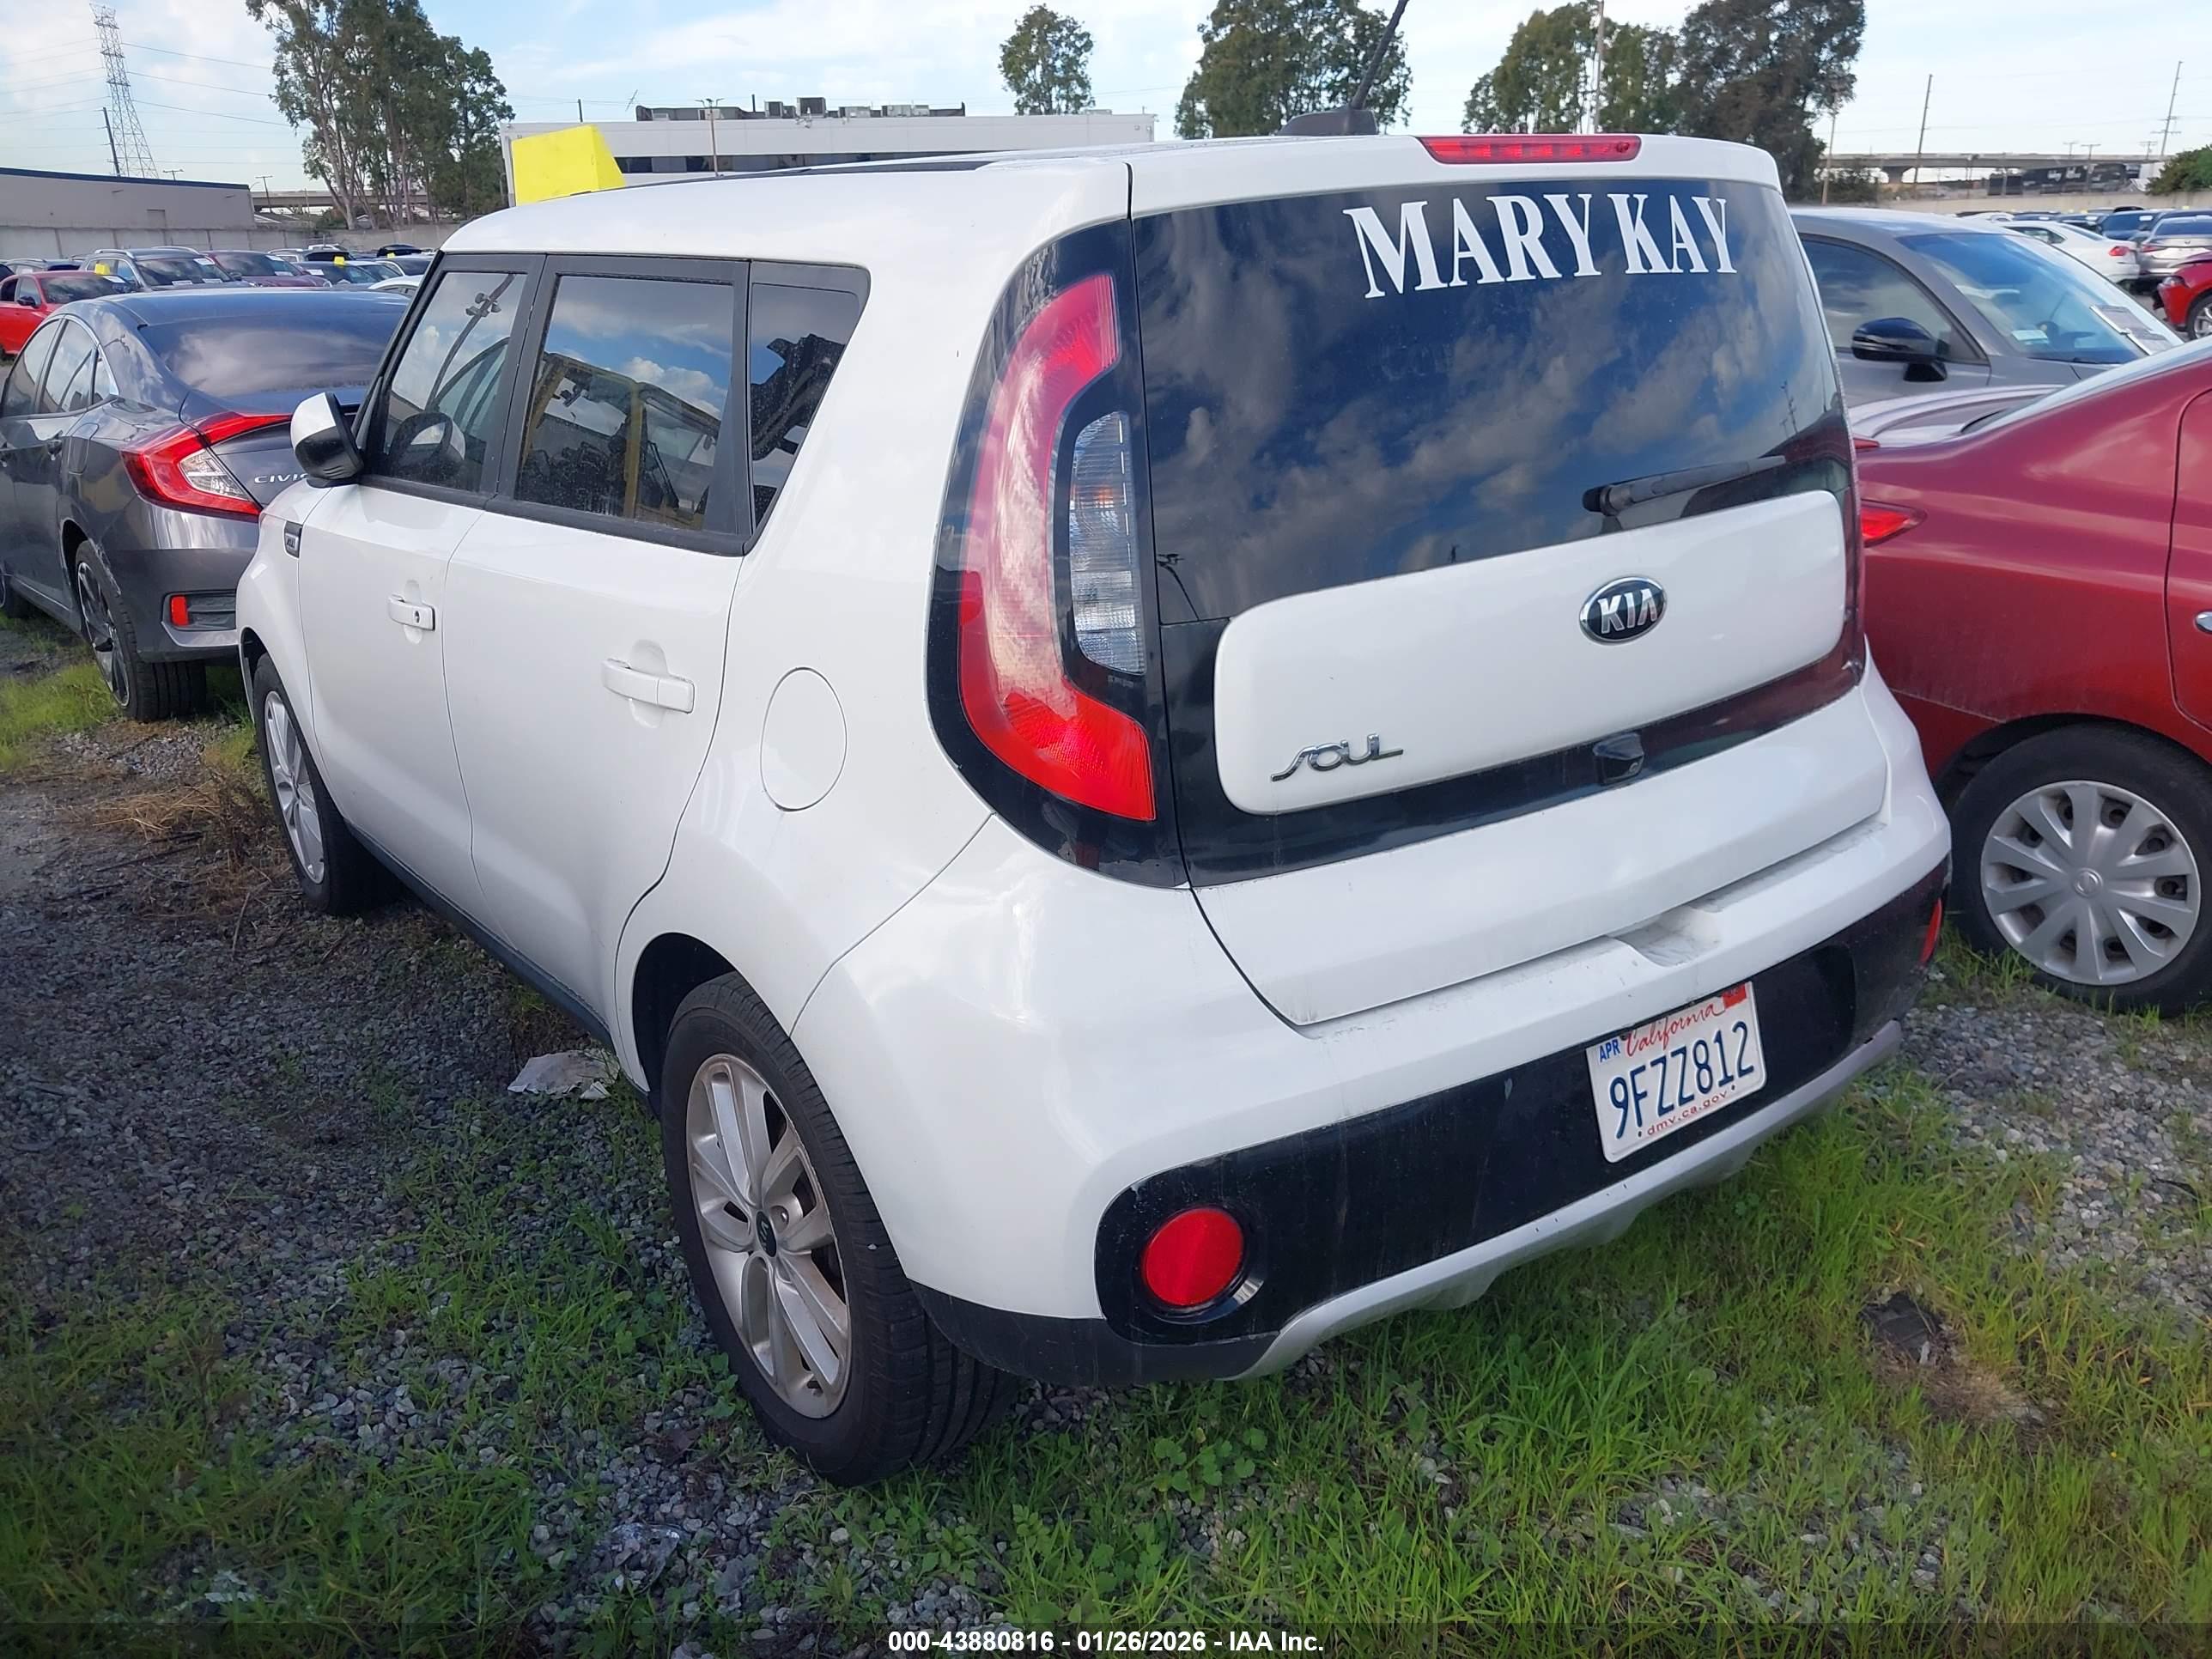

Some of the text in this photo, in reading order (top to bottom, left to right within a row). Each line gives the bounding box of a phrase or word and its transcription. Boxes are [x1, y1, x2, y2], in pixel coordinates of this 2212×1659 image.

[1342, 193, 1738, 299] MARY KAY
[1597, 587, 1658, 635] KIA
[1598, 1038, 1621, 1063] APR
[1623, 1000, 1726, 1057] California
[1608, 1020, 1755, 1139] 9FZZ812
[1646, 1089, 1729, 1136] dmv.ca.gov
